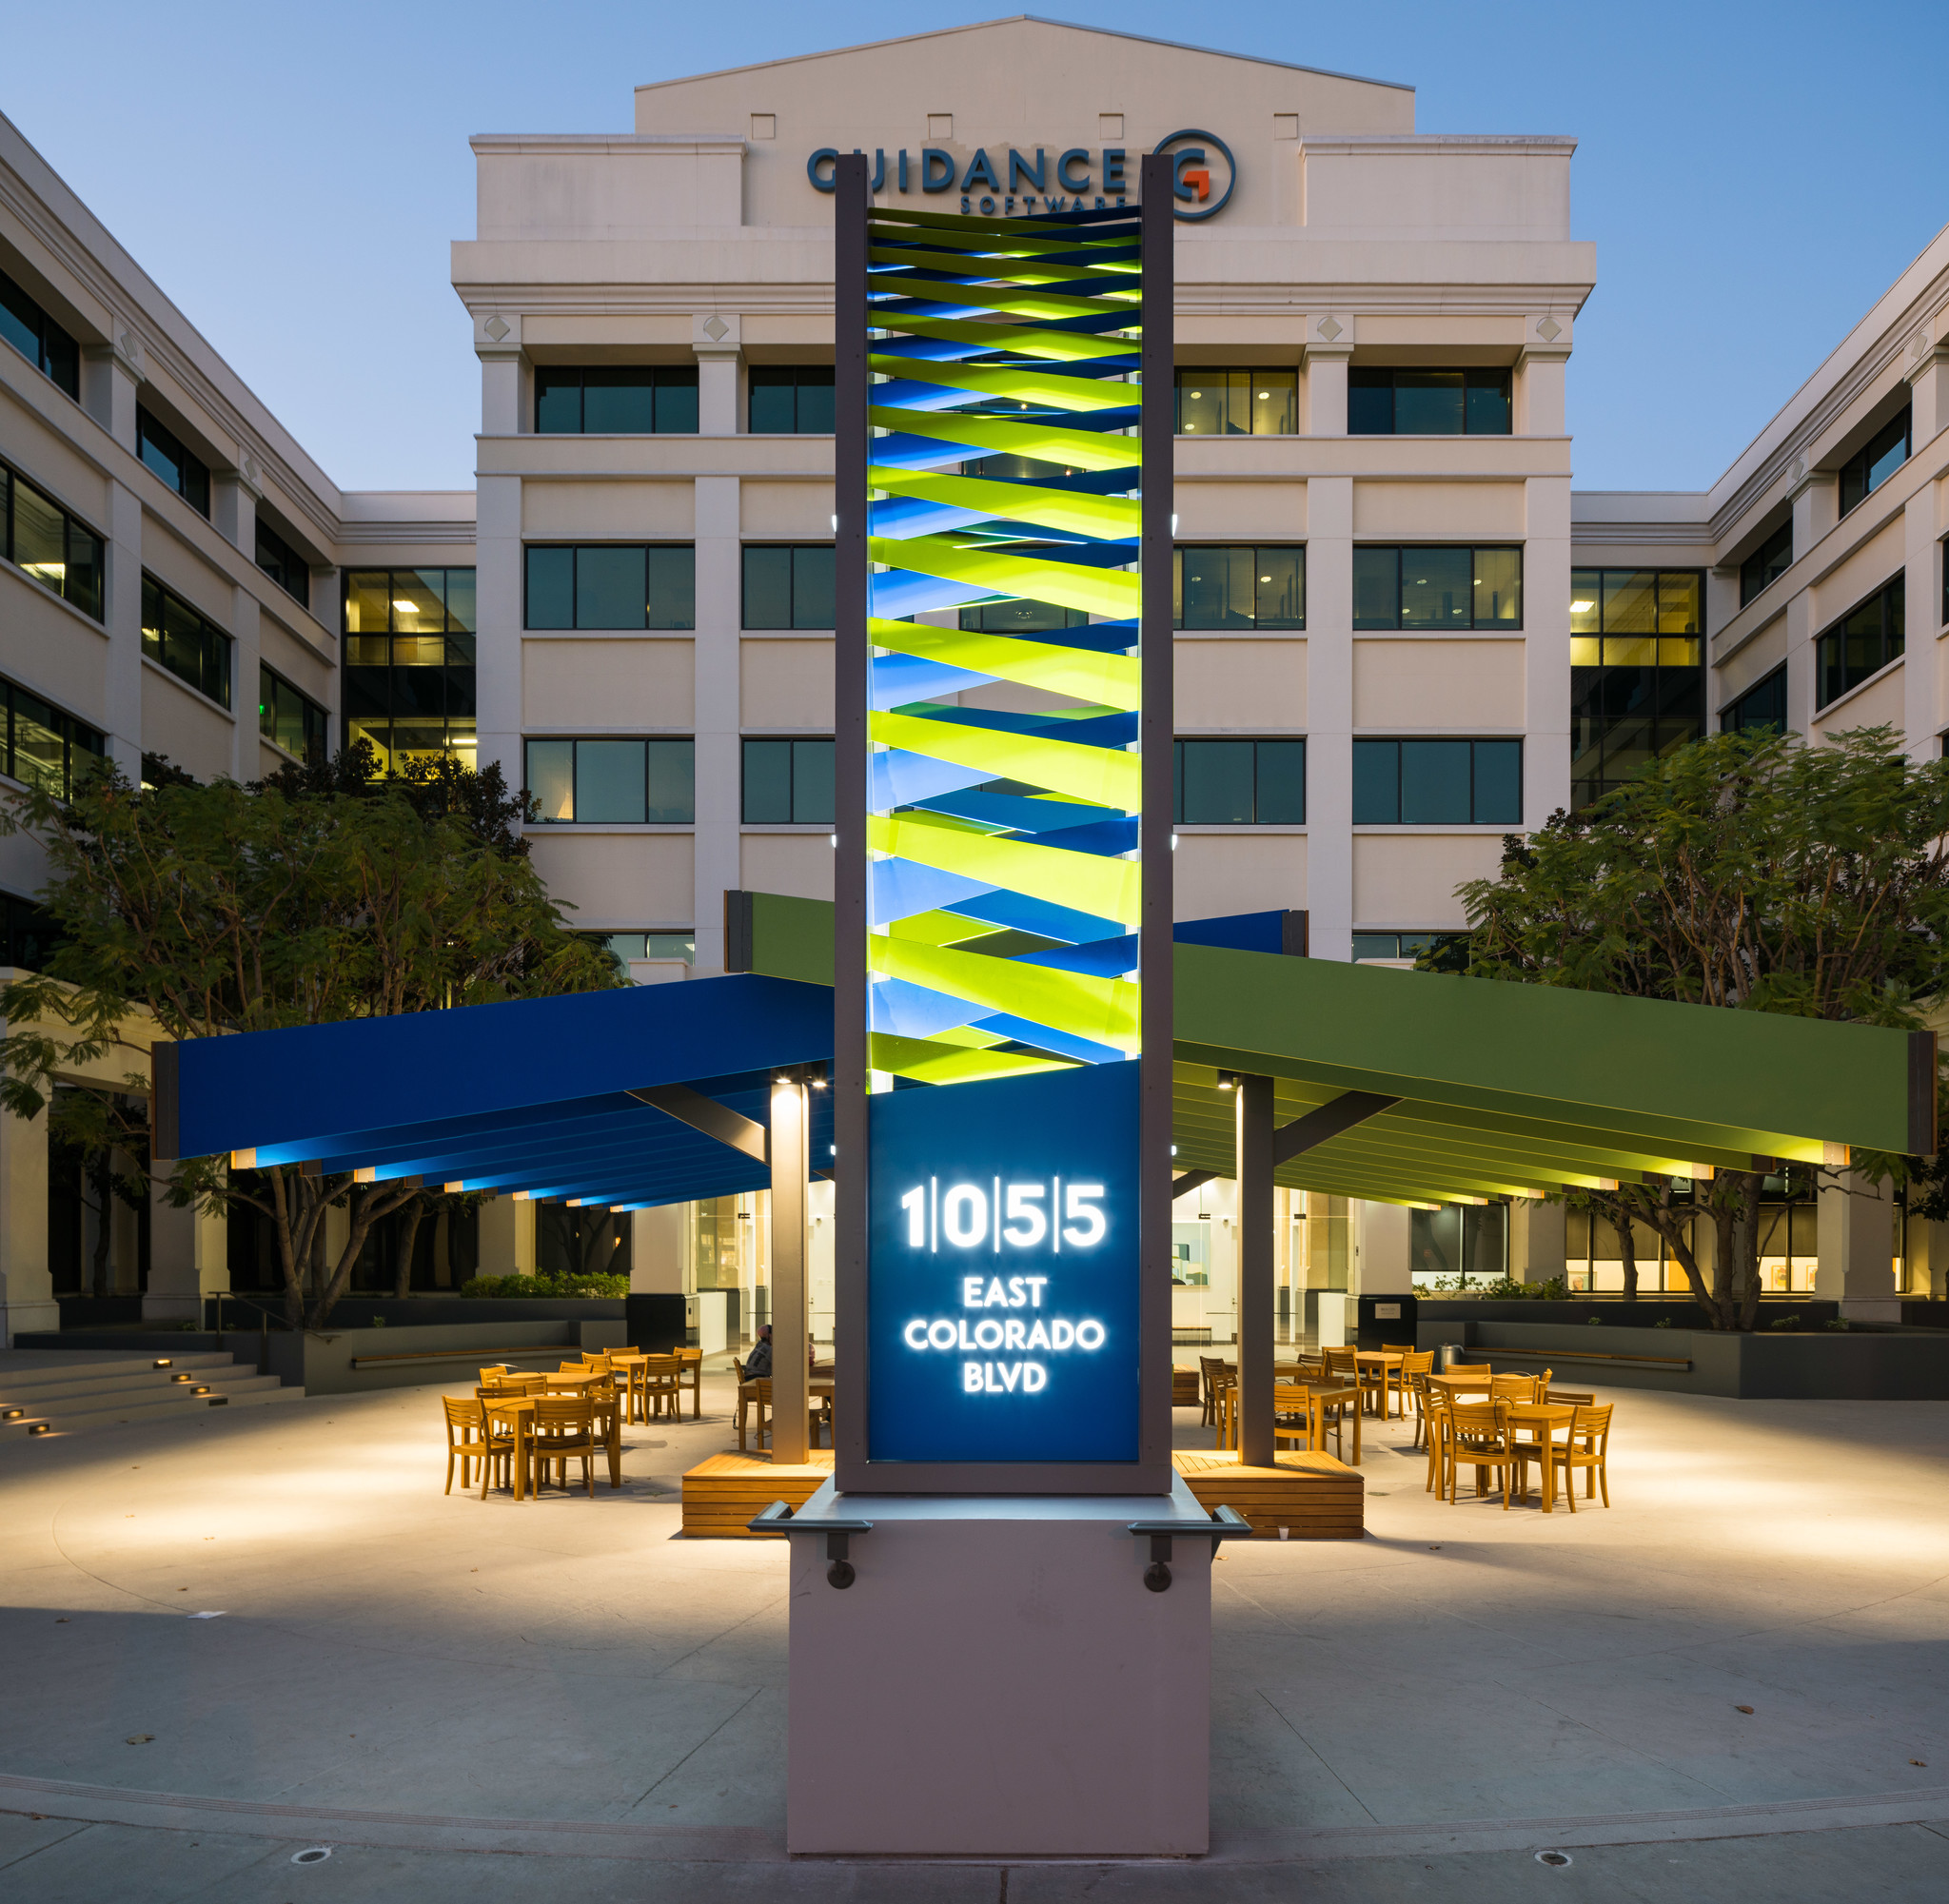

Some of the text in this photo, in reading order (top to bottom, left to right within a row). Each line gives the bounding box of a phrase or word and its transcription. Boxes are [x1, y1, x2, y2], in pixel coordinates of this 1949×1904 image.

[963, 1277, 1048, 1307] EAST
[904, 1319, 1105, 1349] COLORADO
[964, 1363, 1047, 1392] BLVD
